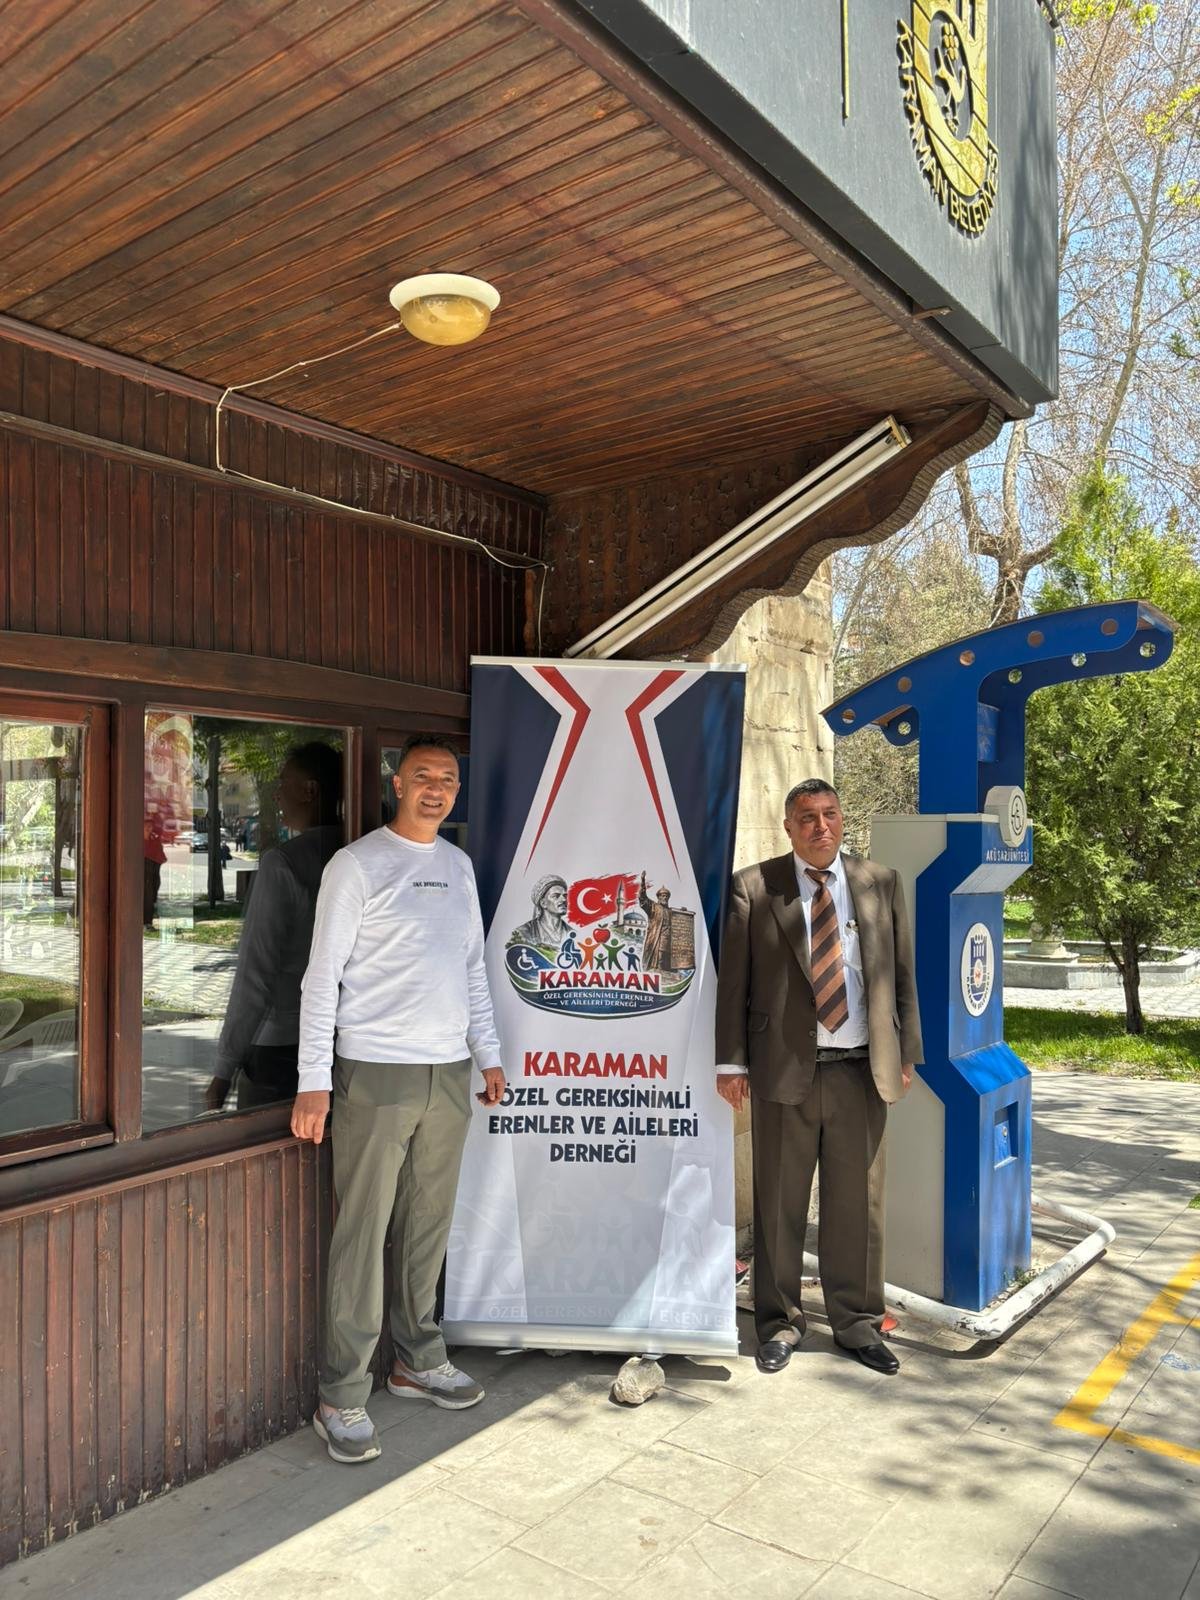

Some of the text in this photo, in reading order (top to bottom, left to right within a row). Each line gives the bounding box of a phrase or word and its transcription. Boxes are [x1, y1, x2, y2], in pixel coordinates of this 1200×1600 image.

[540, 970, 660, 993] KARAMAN
[543, 990, 654, 1003] ÖZEL GEREKSİNİMLİ ERENLER
[605, 1000, 637, 1008] DERNEĞİ
[523, 1051, 668, 1080] KARAMAN
[499, 1082, 691, 1110] ÖZEL GEREKSİNİMLİ
[488, 1111, 699, 1137] ERENLER VE AİLELERİ
[550, 1138, 637, 1164] DERNEĞİ
